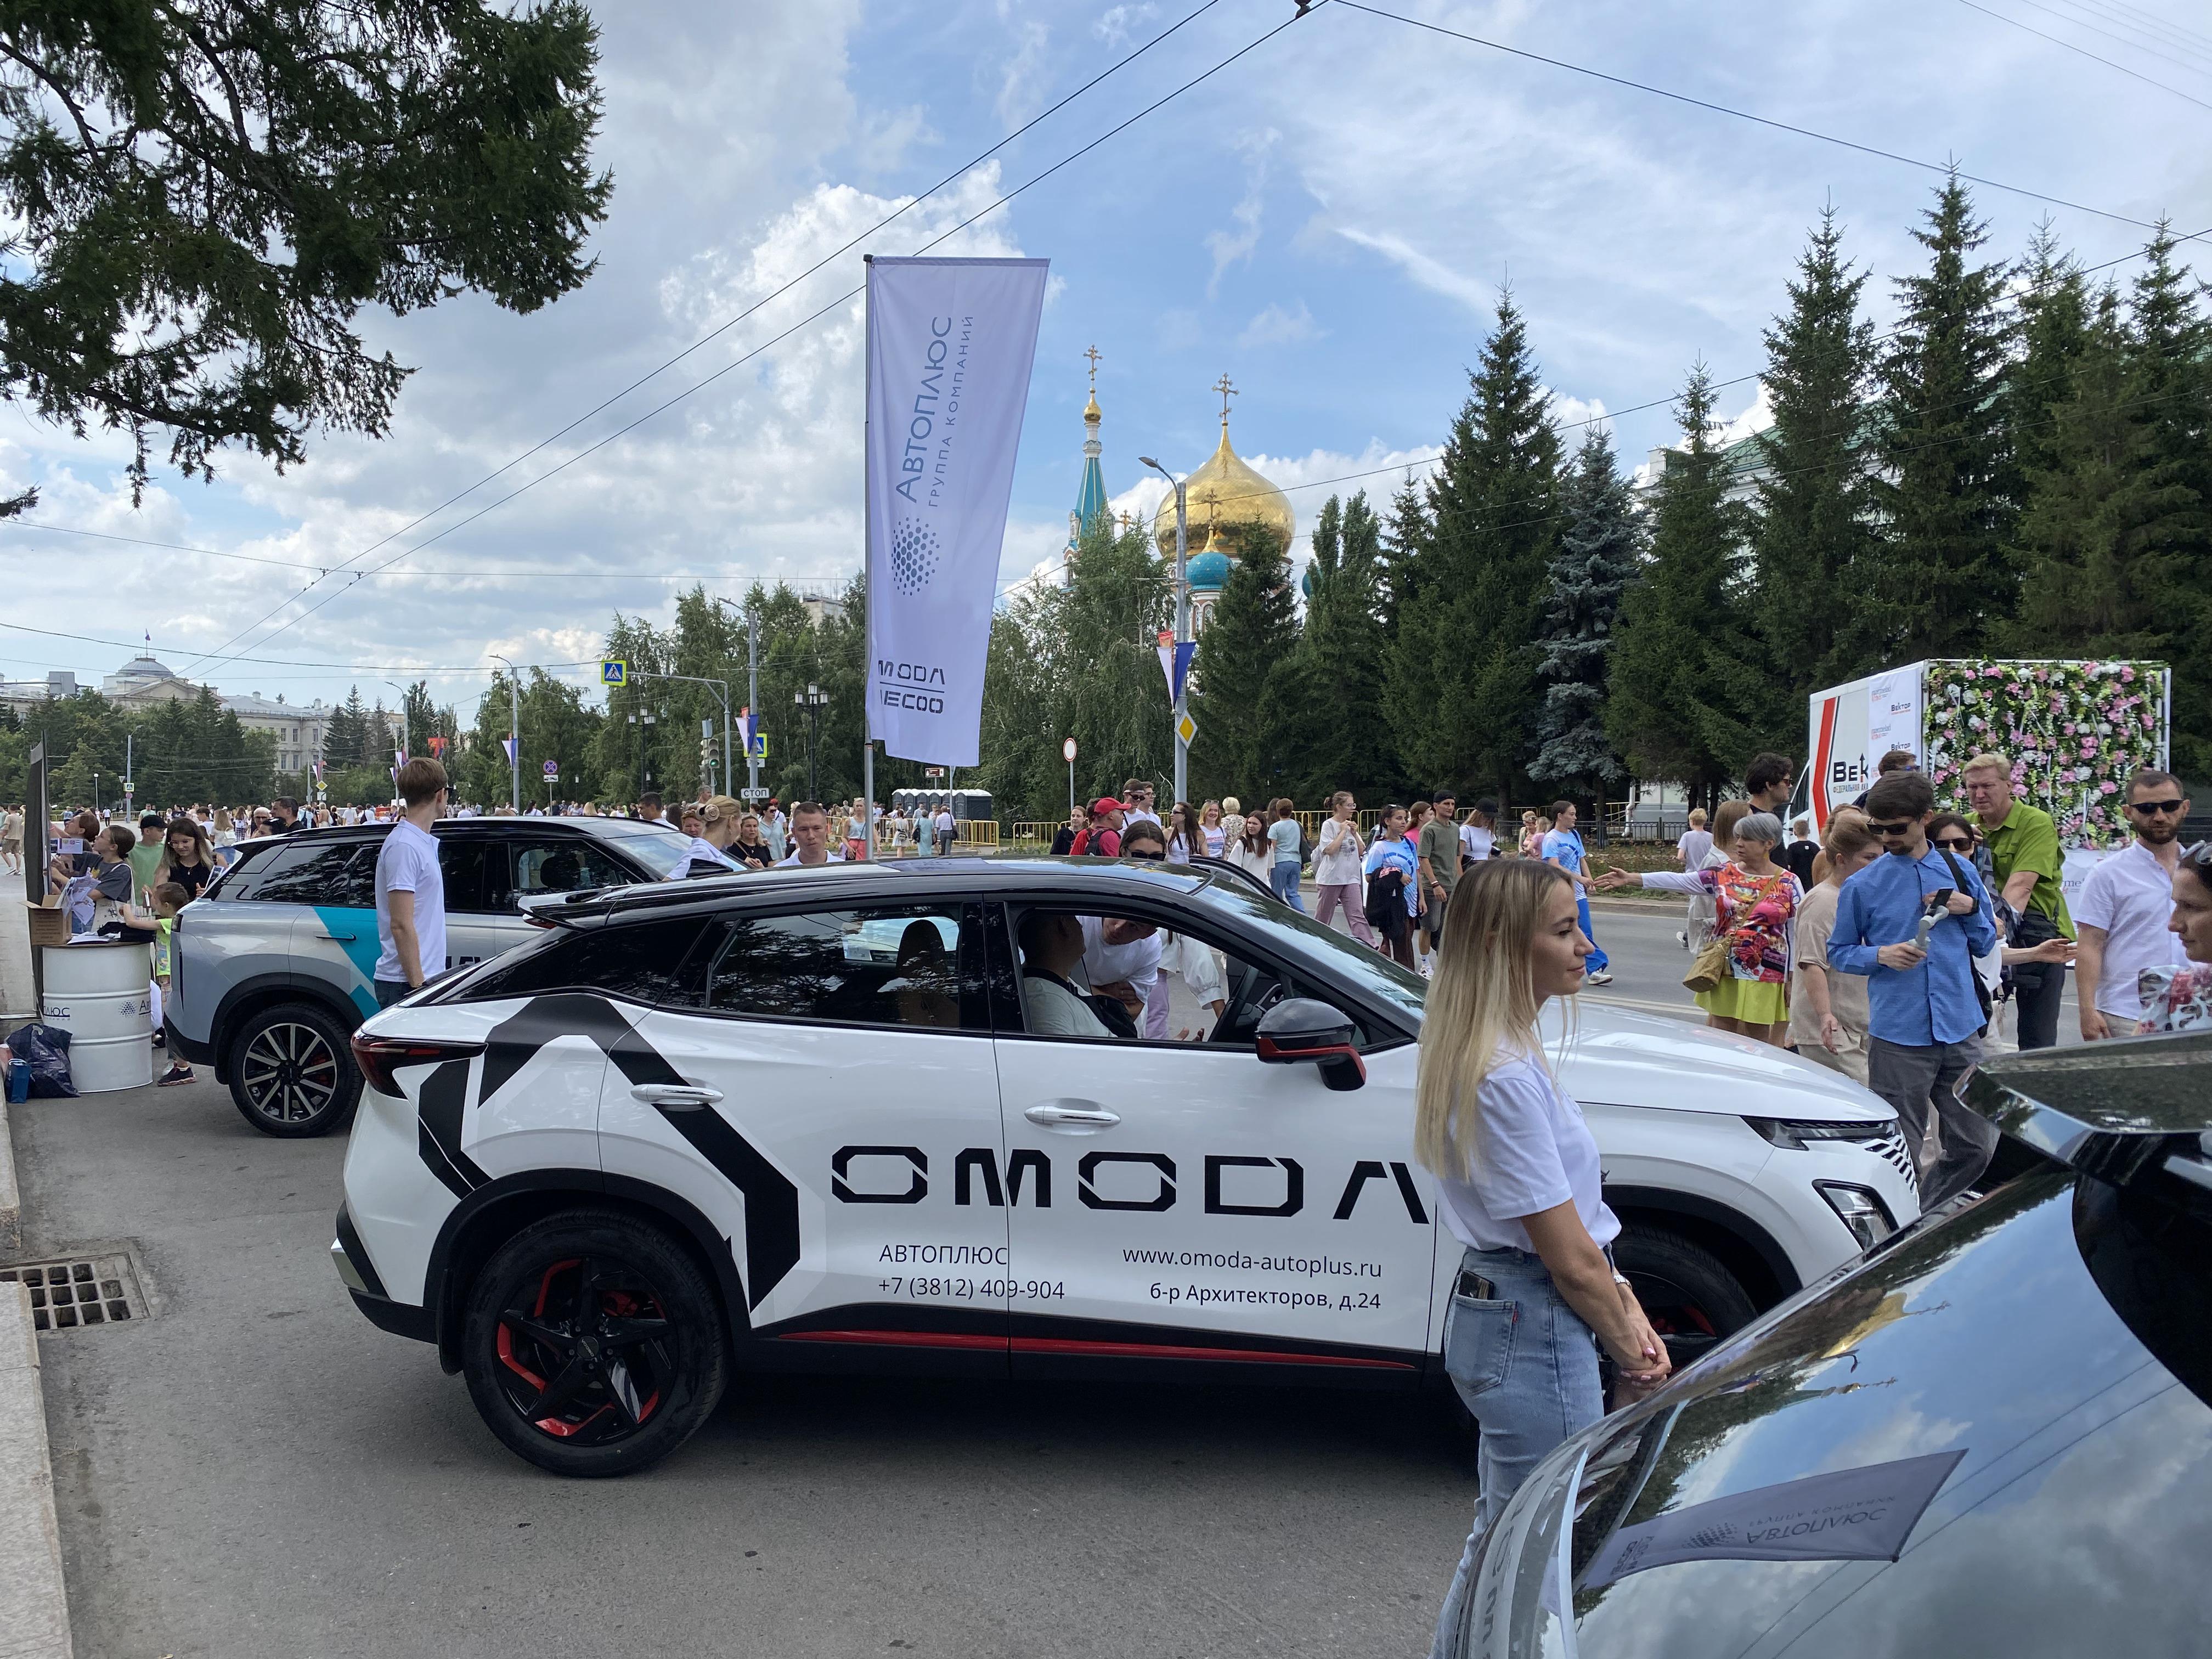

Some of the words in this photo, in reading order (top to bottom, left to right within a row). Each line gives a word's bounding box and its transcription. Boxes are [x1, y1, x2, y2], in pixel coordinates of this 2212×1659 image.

[928, 437, 952, 507] ГРУППА
[945, 317, 974, 426] КОМПАНИЙ
[831, 1145, 1430, 1225] OMODA
[879, 1244, 1008, 1265] АВТОПЛЮС
[1123, 1249, 1381, 1278] www.omoda-autoplus.ru
[878, 1277, 902, 1294] +7
[910, 1277, 974, 1300] (3812)
[980, 1279, 1065, 1300] 409-904
[1150, 1283, 1180, 1305] б-р
[1186, 1284, 1333, 1310] Архитекторов,
[1339, 1293, 1381, 1312] д.24
